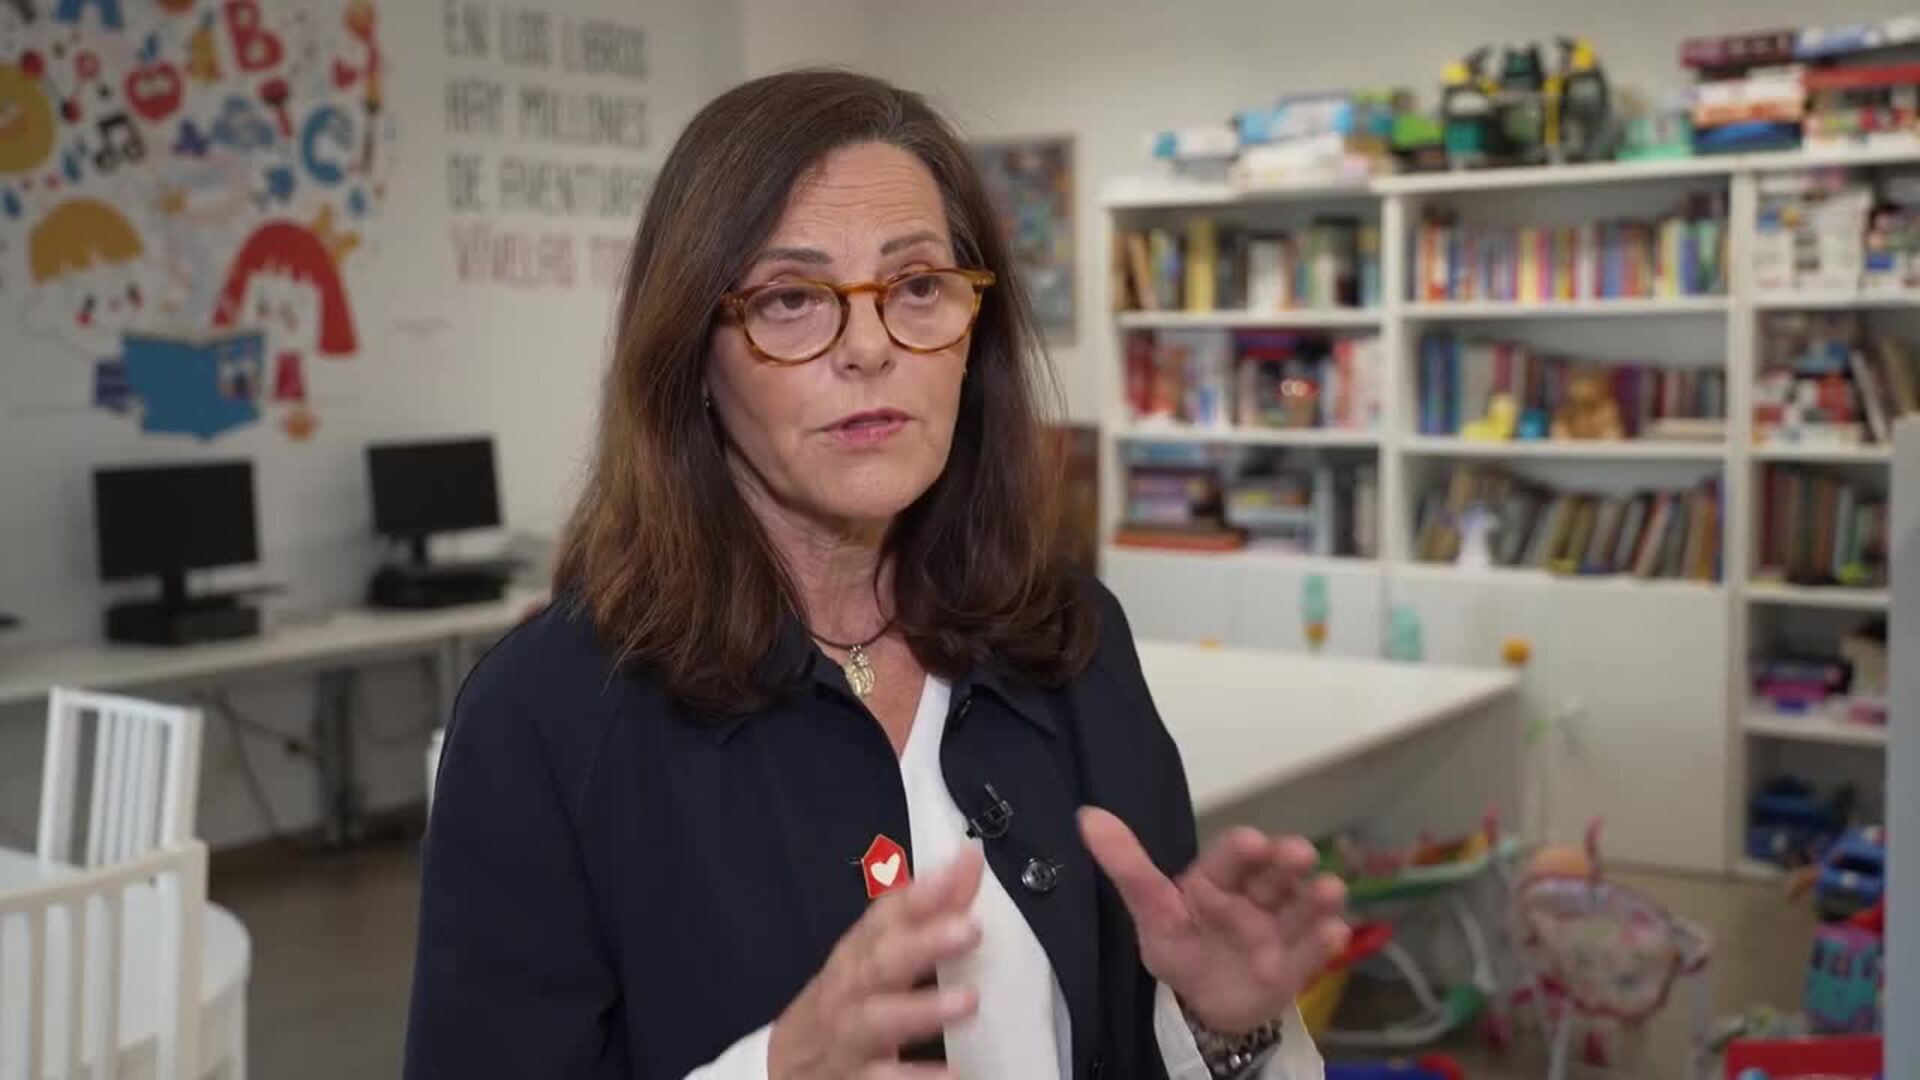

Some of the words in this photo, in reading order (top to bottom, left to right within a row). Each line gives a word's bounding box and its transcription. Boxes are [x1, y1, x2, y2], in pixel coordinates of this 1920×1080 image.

[501, 9, 552, 68] LOS
[444, 80, 503, 136] HAY
[448, 152, 483, 212] DE
